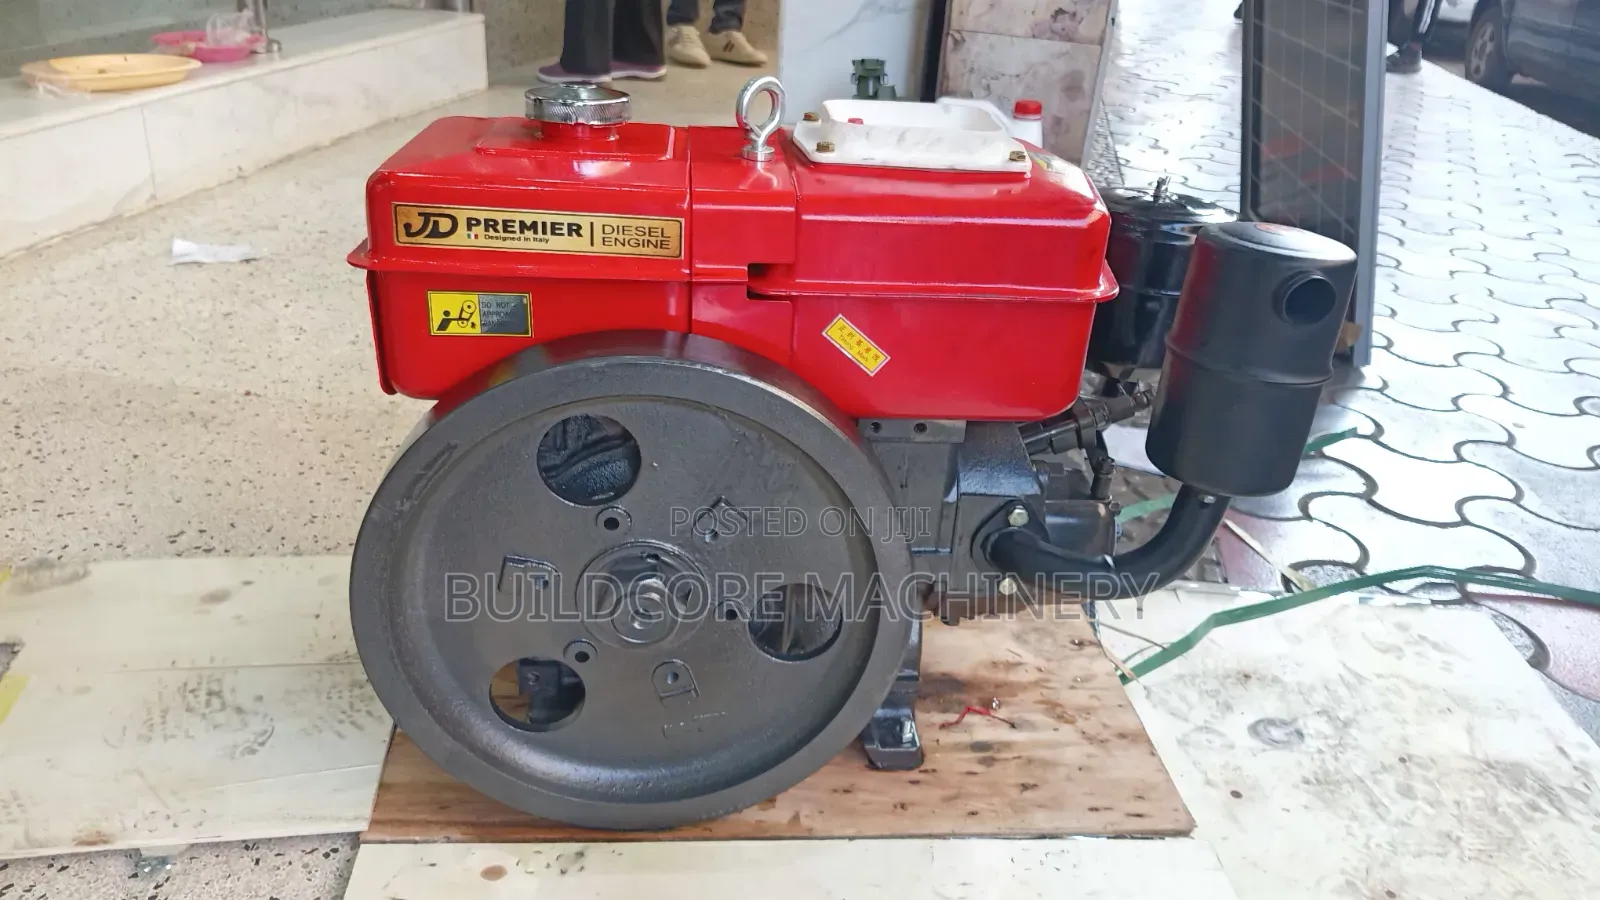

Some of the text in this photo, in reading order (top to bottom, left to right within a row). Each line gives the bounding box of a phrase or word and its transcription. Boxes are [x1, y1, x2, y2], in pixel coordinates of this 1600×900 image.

[404, 211, 583, 239] JD PREMIER
[602, 224, 671, 239] DIESEL
[484, 233, 521, 244] Designed
[533, 236, 550, 245] Italy
[602, 237, 671, 250] ENGINE
[481, 301, 492, 309] DO
